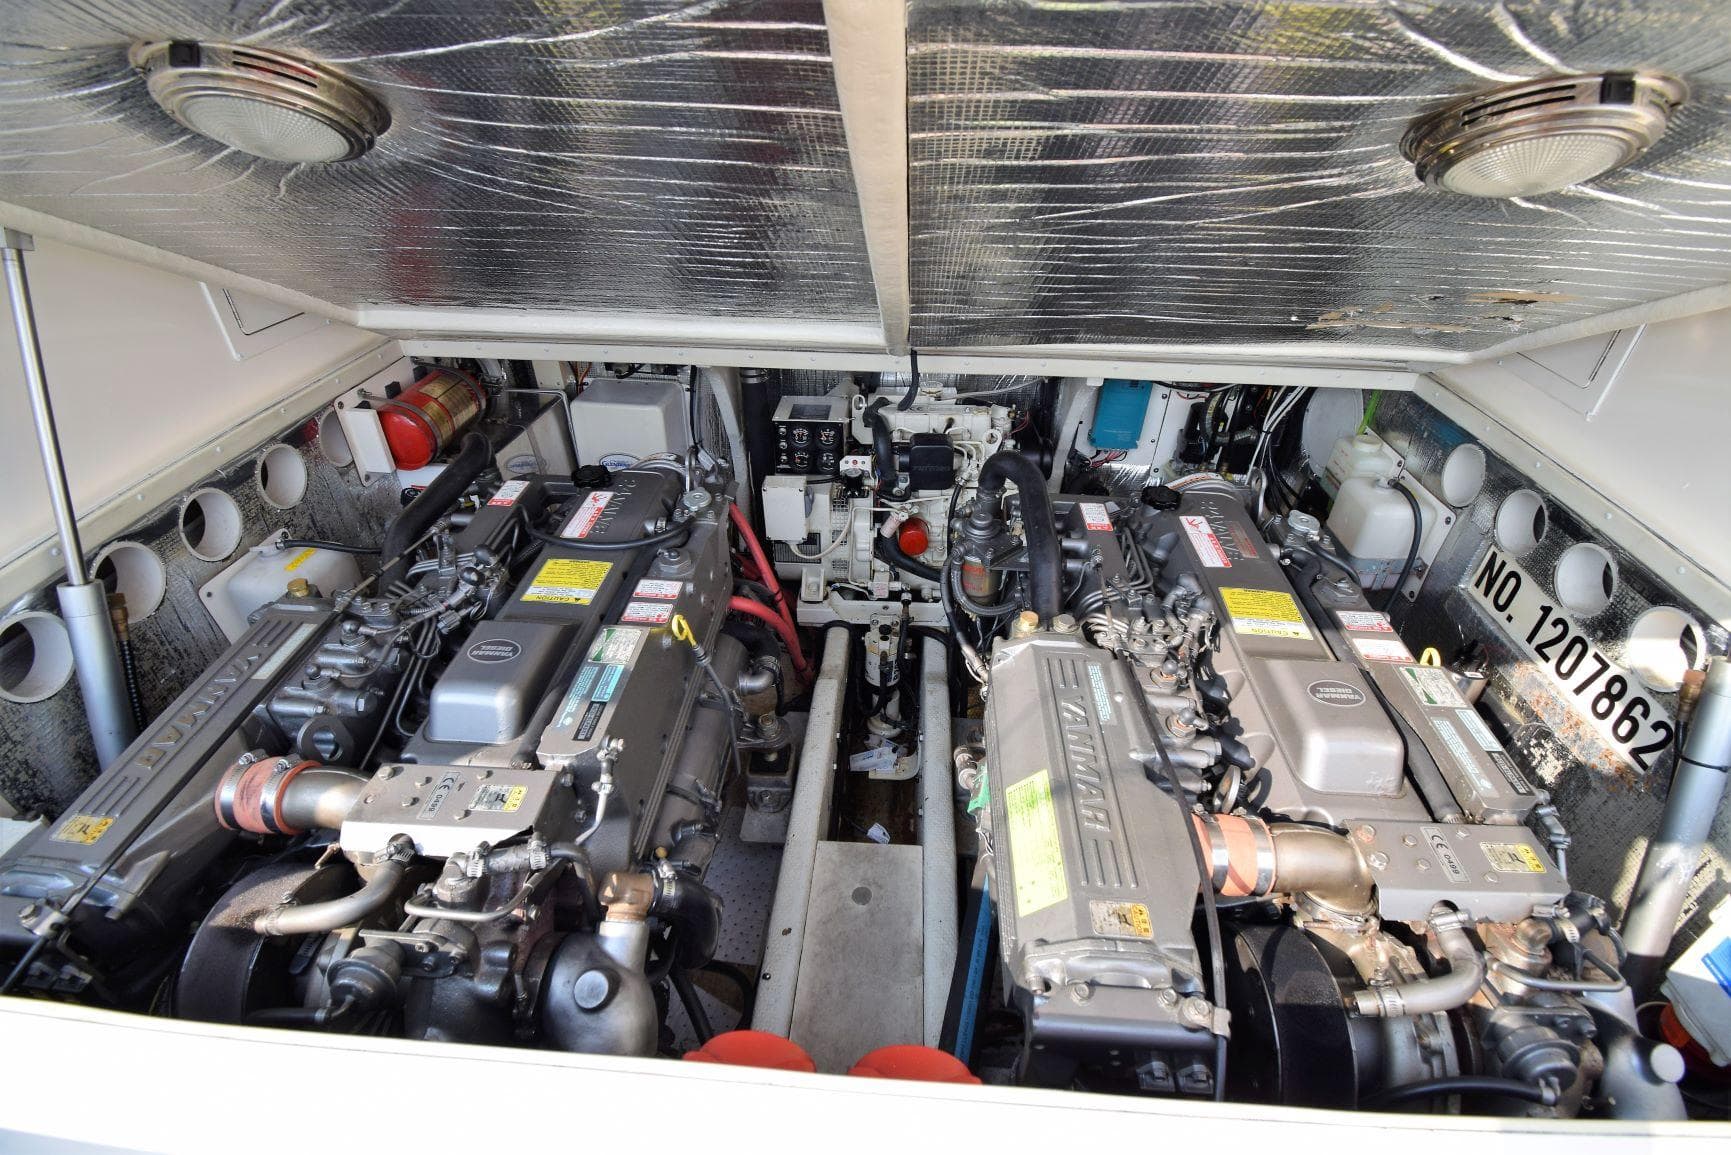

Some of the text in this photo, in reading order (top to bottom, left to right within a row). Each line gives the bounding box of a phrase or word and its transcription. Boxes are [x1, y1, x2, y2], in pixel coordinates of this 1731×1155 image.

[137, 653, 259, 770] YANMAR
[1315, 692, 1362, 701] YANMAR
[1473, 550, 1522, 623] NO.
[1525, 604, 1674, 772] 1207862
[1061, 695, 1111, 832] YANMAR
